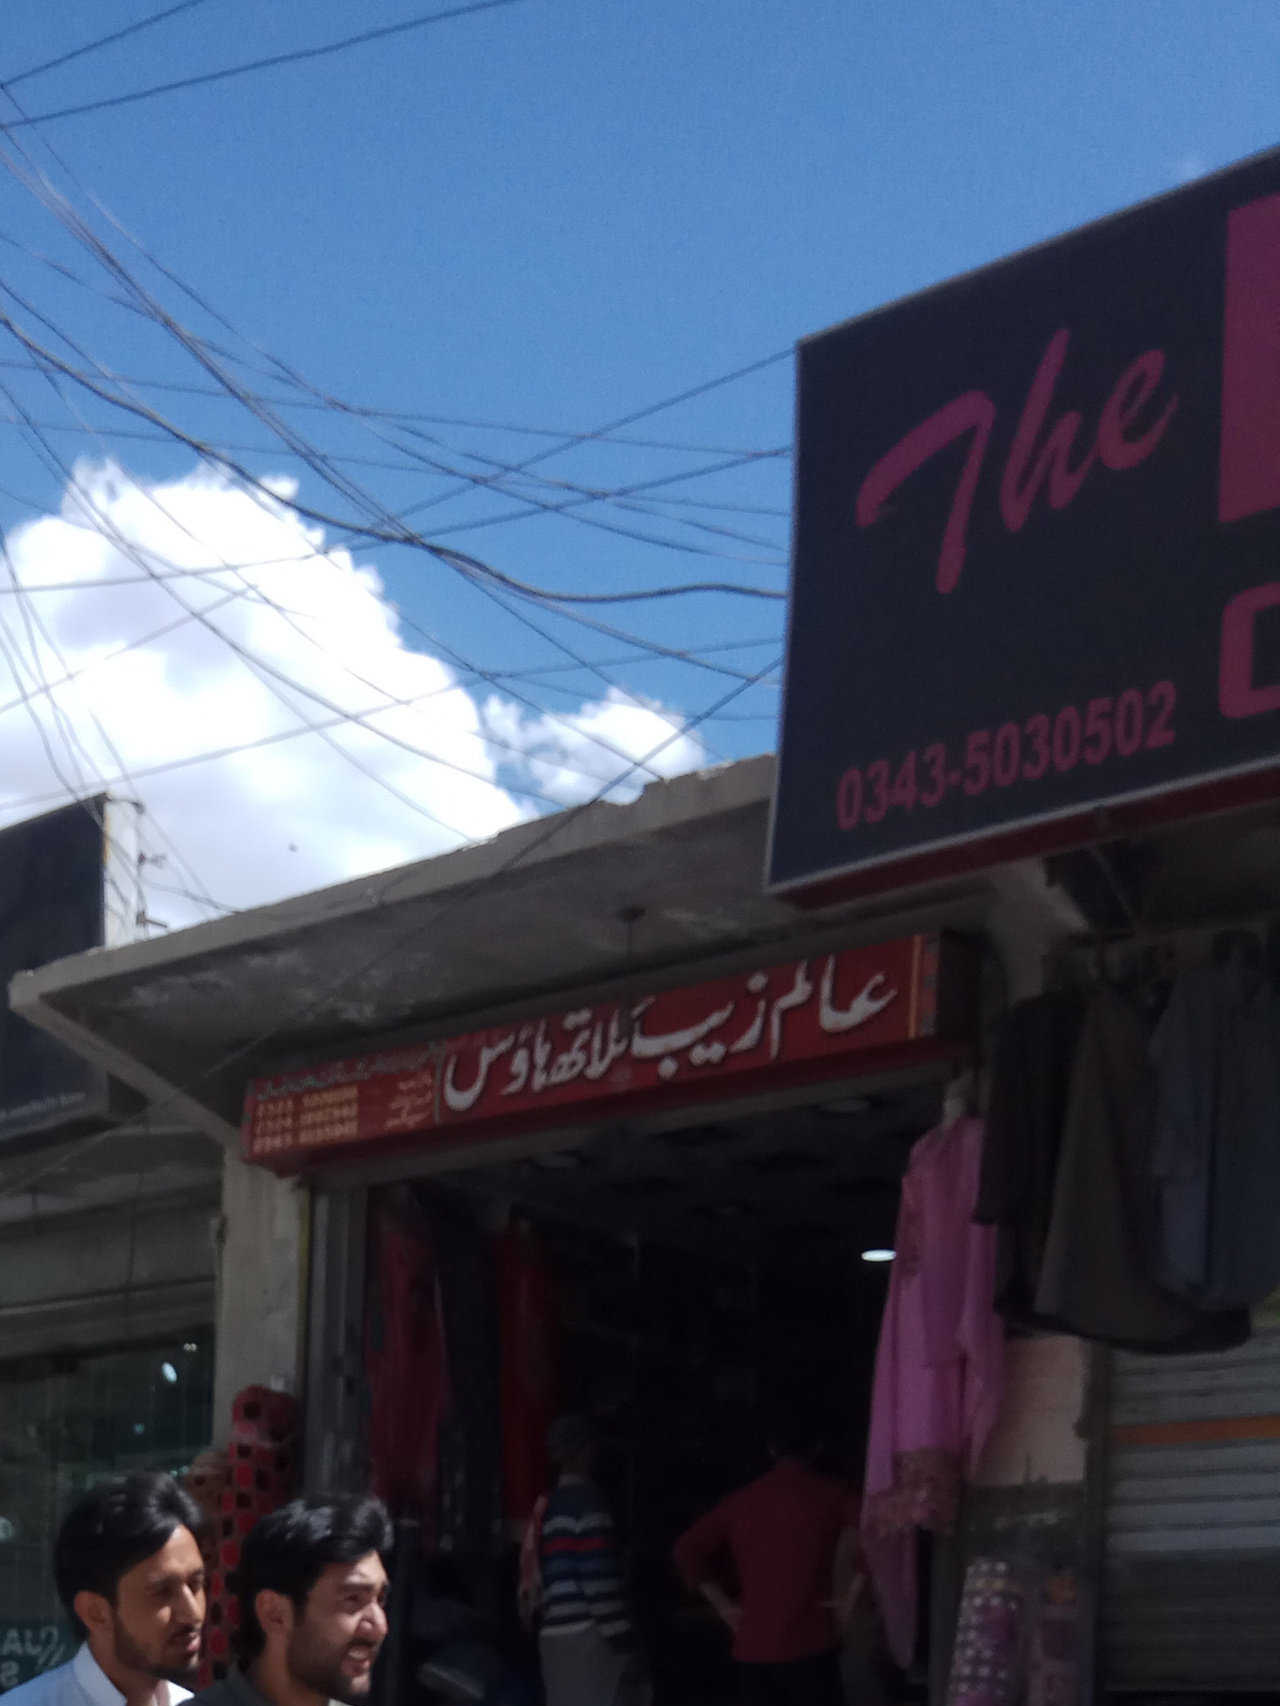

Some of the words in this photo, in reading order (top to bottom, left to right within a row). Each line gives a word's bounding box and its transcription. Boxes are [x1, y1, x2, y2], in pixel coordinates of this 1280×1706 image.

[856, 328, 1178, 594] The
[836, 681, 1176, 831] 0343-5030502
[770, 954, 898, 1060] عالم
